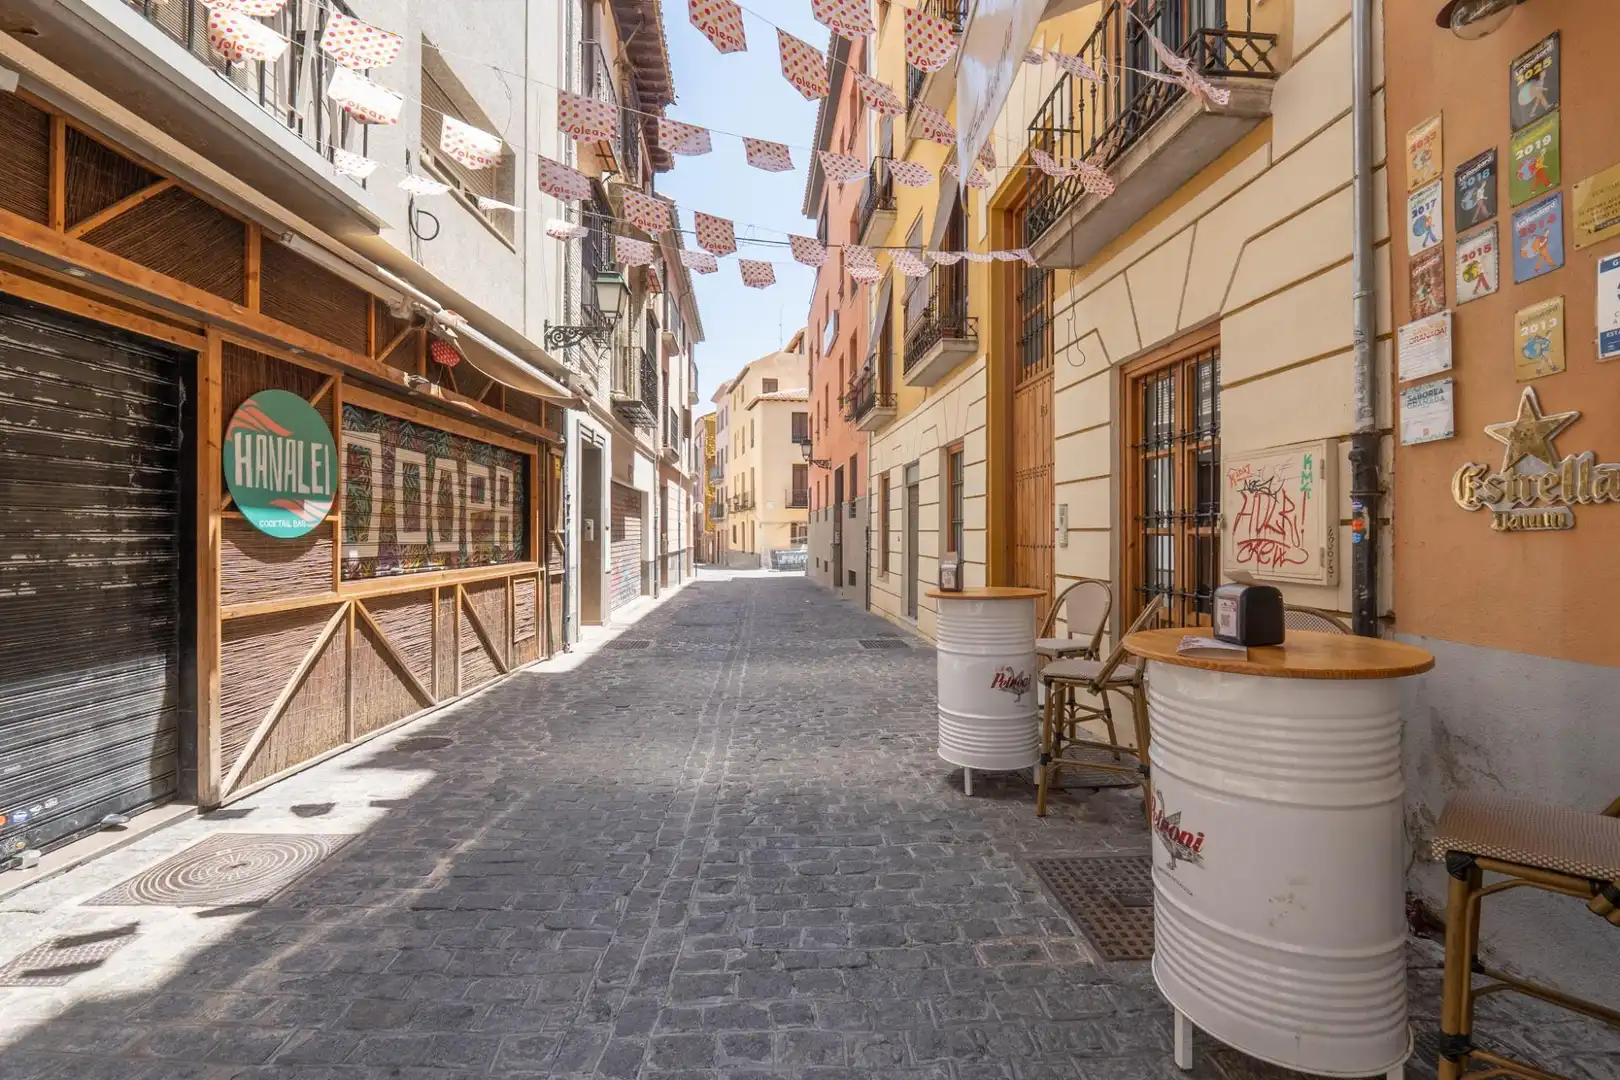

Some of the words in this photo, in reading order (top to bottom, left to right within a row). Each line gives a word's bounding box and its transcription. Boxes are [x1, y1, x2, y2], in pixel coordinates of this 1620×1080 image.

[699, 21, 740, 46] Solear
[217, 39, 264, 56] Solear
[789, 71, 824, 93] Solear
[565, 124, 606, 137] Solear
[450, 146, 491, 165] Solear
[1516, 134, 1552, 160] 2019
[1412, 199, 1437, 218] 2017
[632, 216, 662, 230] Solear
[704, 241, 731, 251] Solear
[235, 432, 330, 495] HANALEI
[1453, 453, 1620, 511] Estrella
[259, 520, 292, 528] COCKTAIL
[293, 520, 307, 528] BAR
[1492, 511, 1567, 531] Damm
